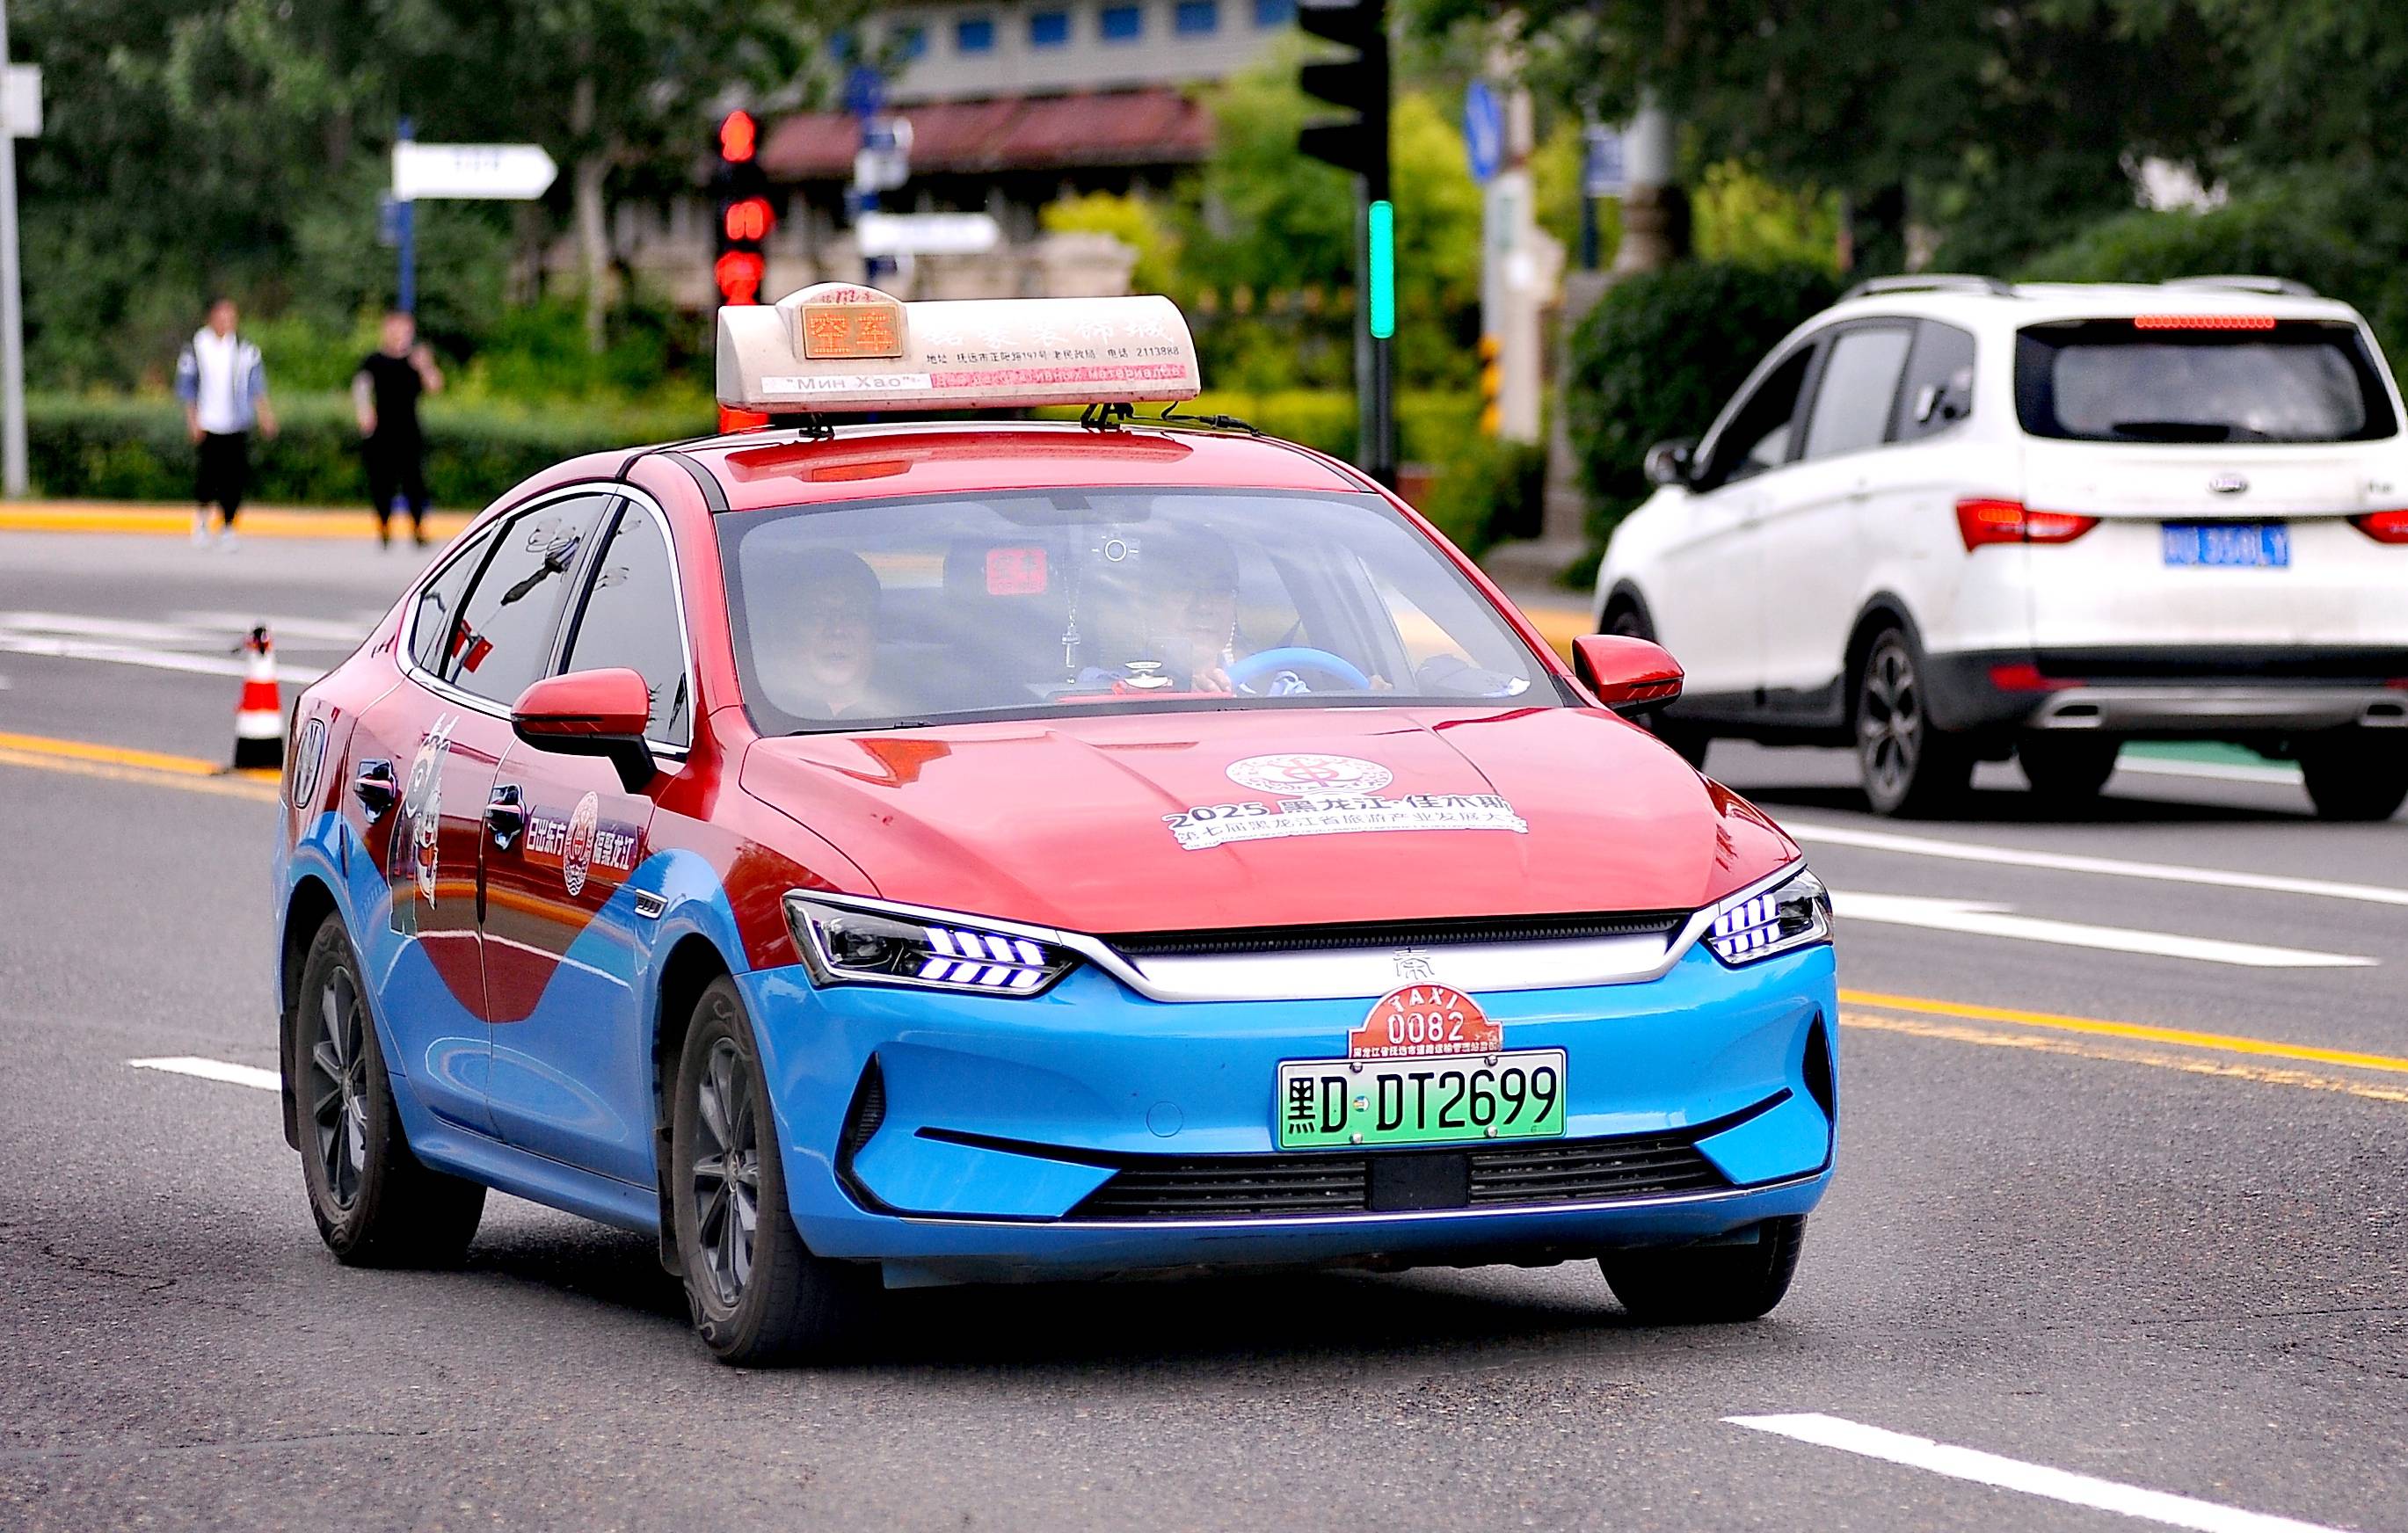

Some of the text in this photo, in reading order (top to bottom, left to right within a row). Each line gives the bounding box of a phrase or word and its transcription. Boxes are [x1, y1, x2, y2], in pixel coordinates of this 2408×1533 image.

[810, 312, 894, 353] 空车
[927, 352, 948, 365] 地址
[1107, 347, 1129, 359] 电话
[1167, 803, 1269, 829] 2025
[526, 817, 567, 856] 日出东方
[1388, 987, 1459, 1013] TAXI
[1387, 1012, 1465, 1044] 0082
[1377, 1066, 1557, 1131] DT2699
